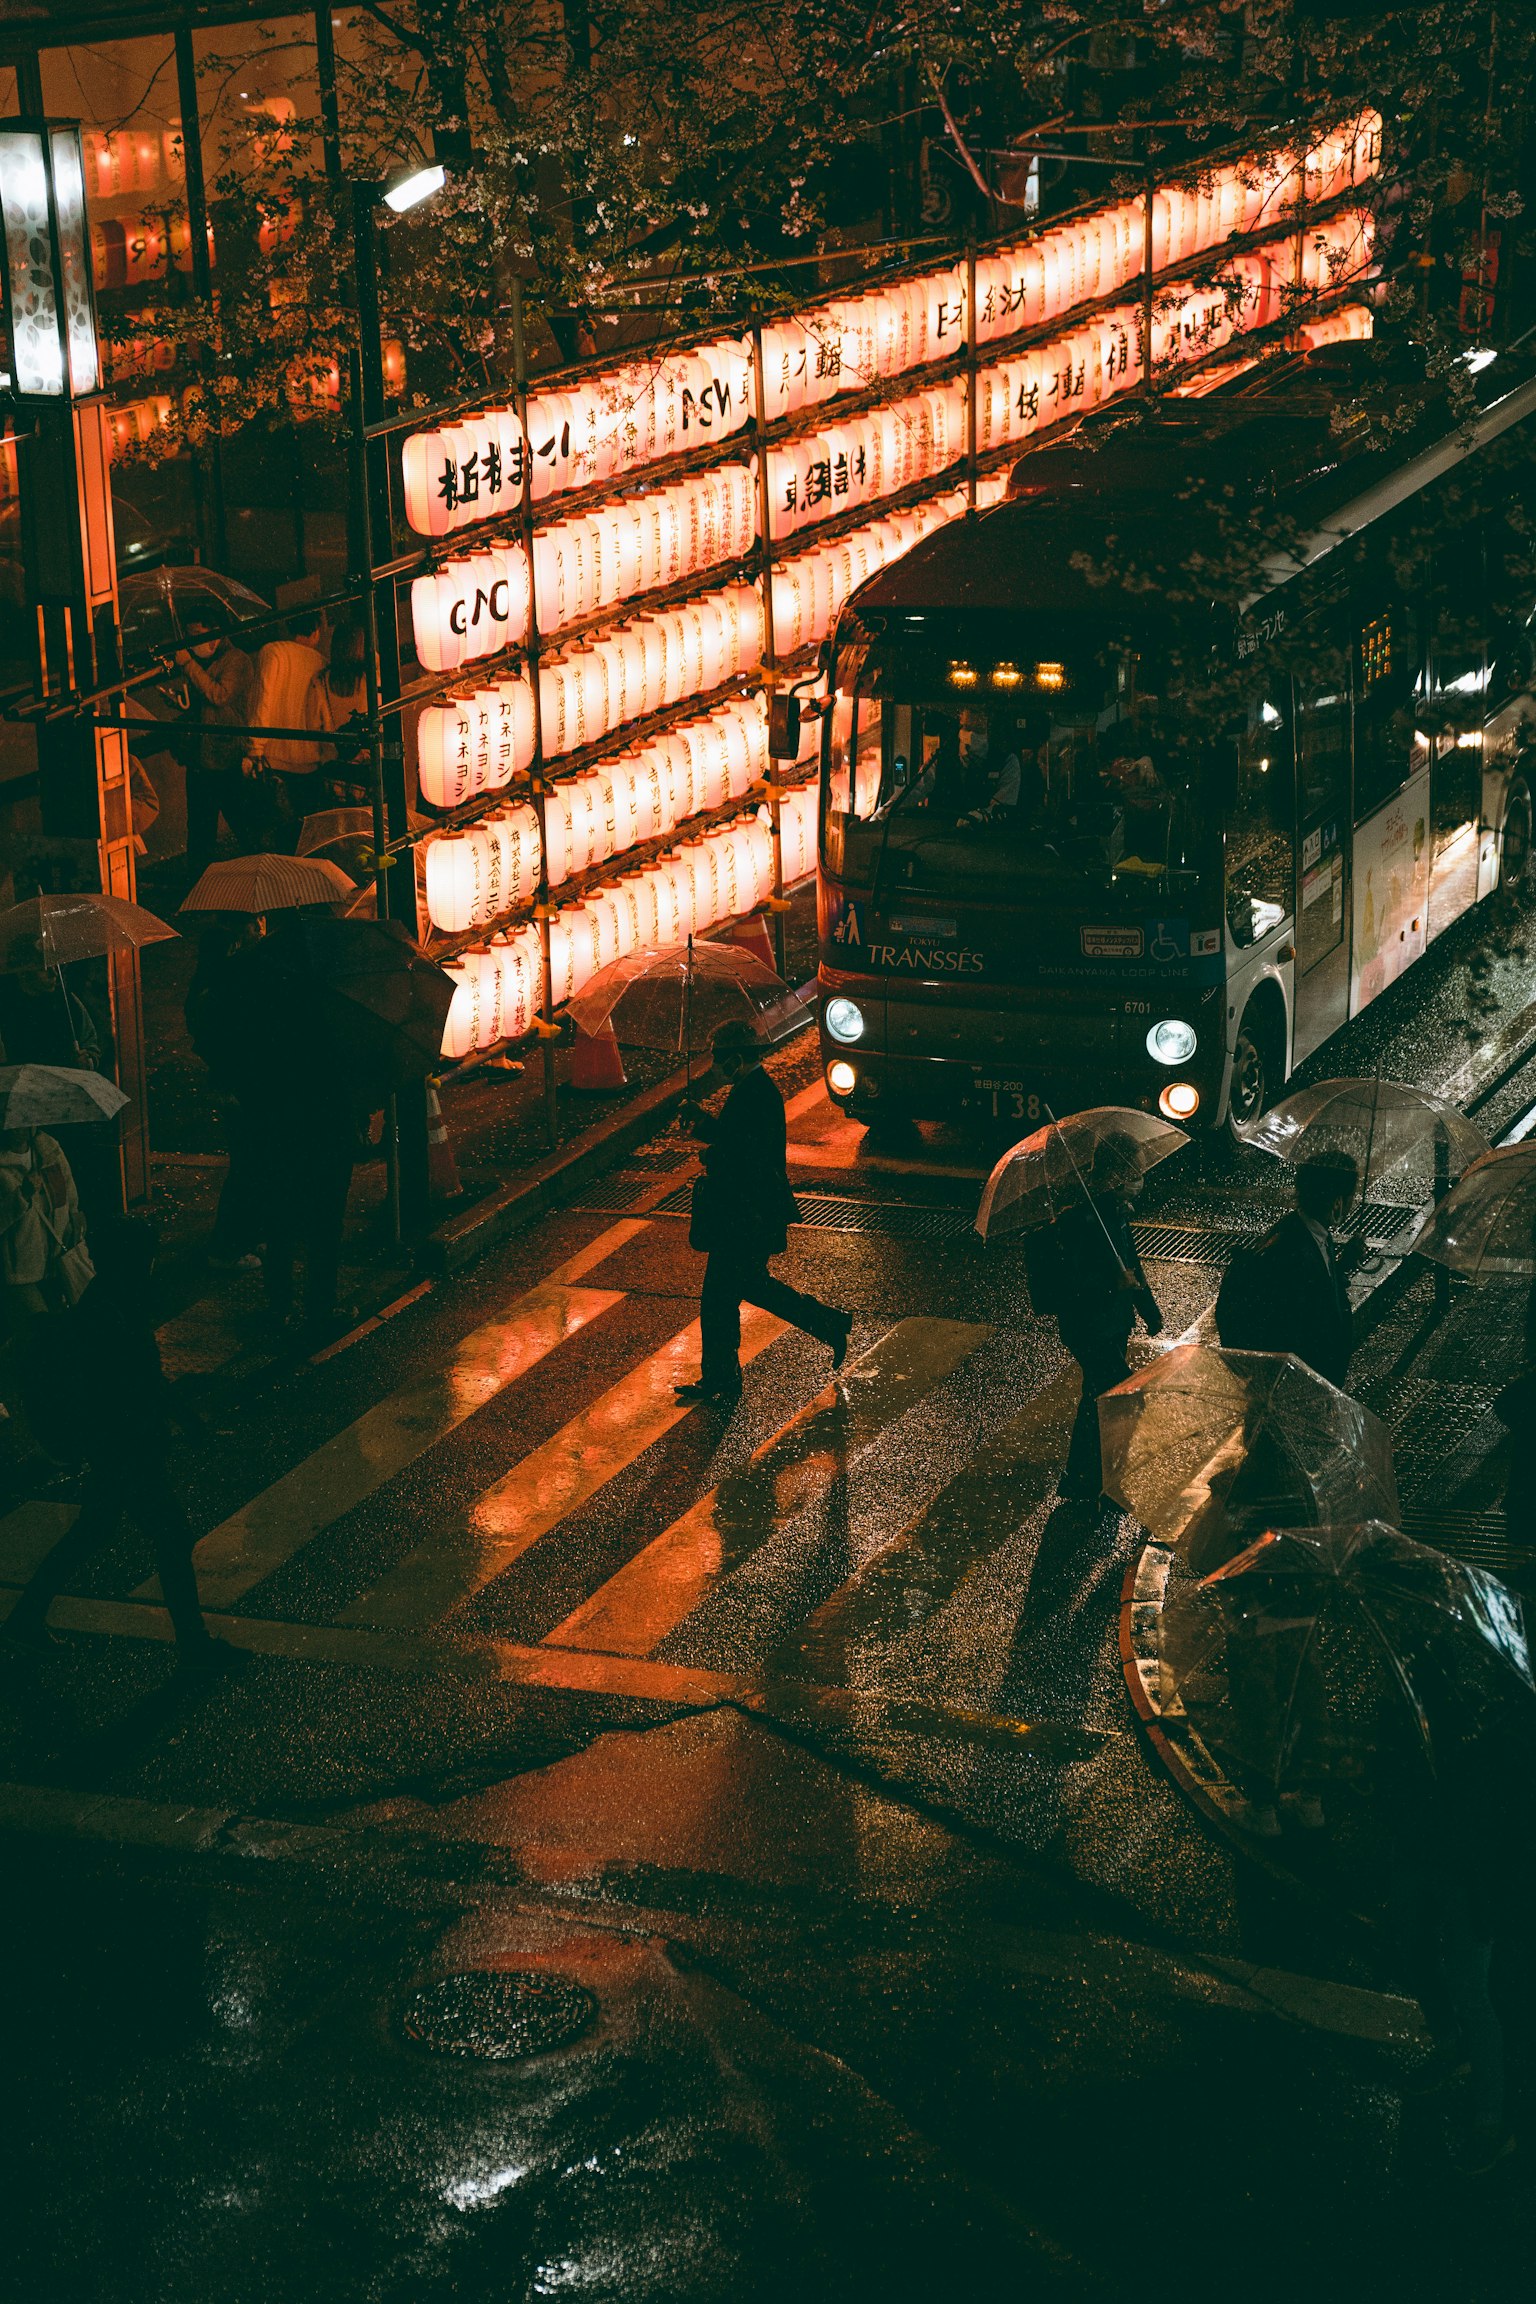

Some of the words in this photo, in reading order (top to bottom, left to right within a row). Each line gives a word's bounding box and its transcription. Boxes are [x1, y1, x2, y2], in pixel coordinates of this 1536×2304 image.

[1237, 609, 1285, 660] 東急トランセ
[455, 720, 470, 797] カネヨシ
[475, 711, 489, 786] カネヨシ
[497, 702, 512, 778] カネヨシ
[867, 944, 985, 974] TRANSSÉS
[908, 936, 941, 948] TOKYU
[1038, 966, 1117, 977] DAIKANYAMA
[1121, 967, 1156, 977] LOOP
[1161, 967, 1189, 977] LINE
[1124, 1002, 1151, 1014] 6701
